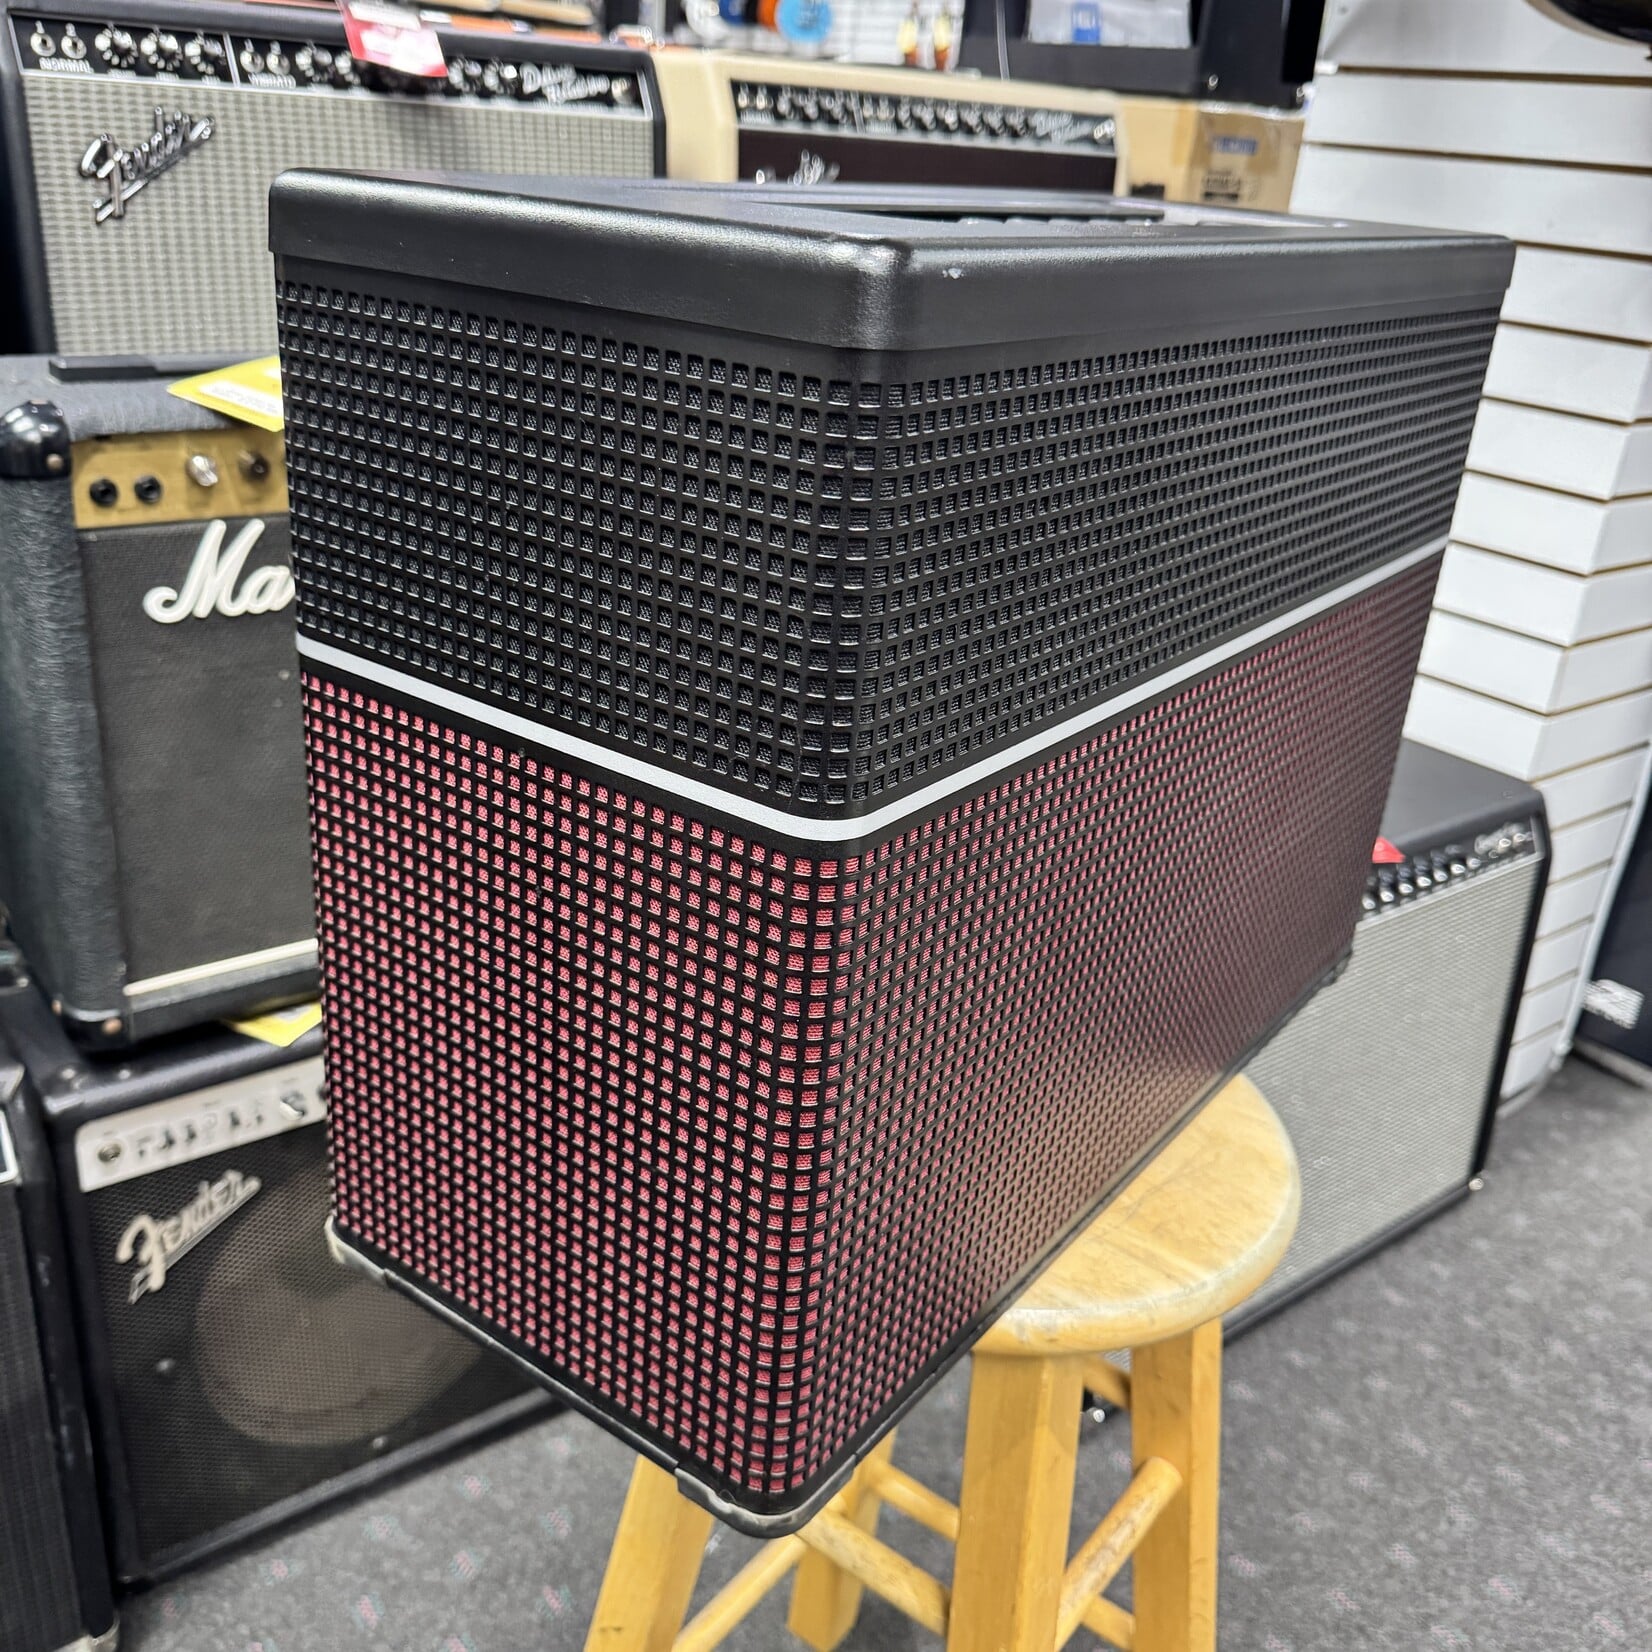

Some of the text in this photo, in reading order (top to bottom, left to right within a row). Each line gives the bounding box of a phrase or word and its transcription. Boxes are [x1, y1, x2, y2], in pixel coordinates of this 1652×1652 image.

[39, 57, 94, 73] NORMAL
[79, 106, 214, 223] Fender
[143, 518, 296, 624] Ma
[115, 1169, 261, 1304] Fender
